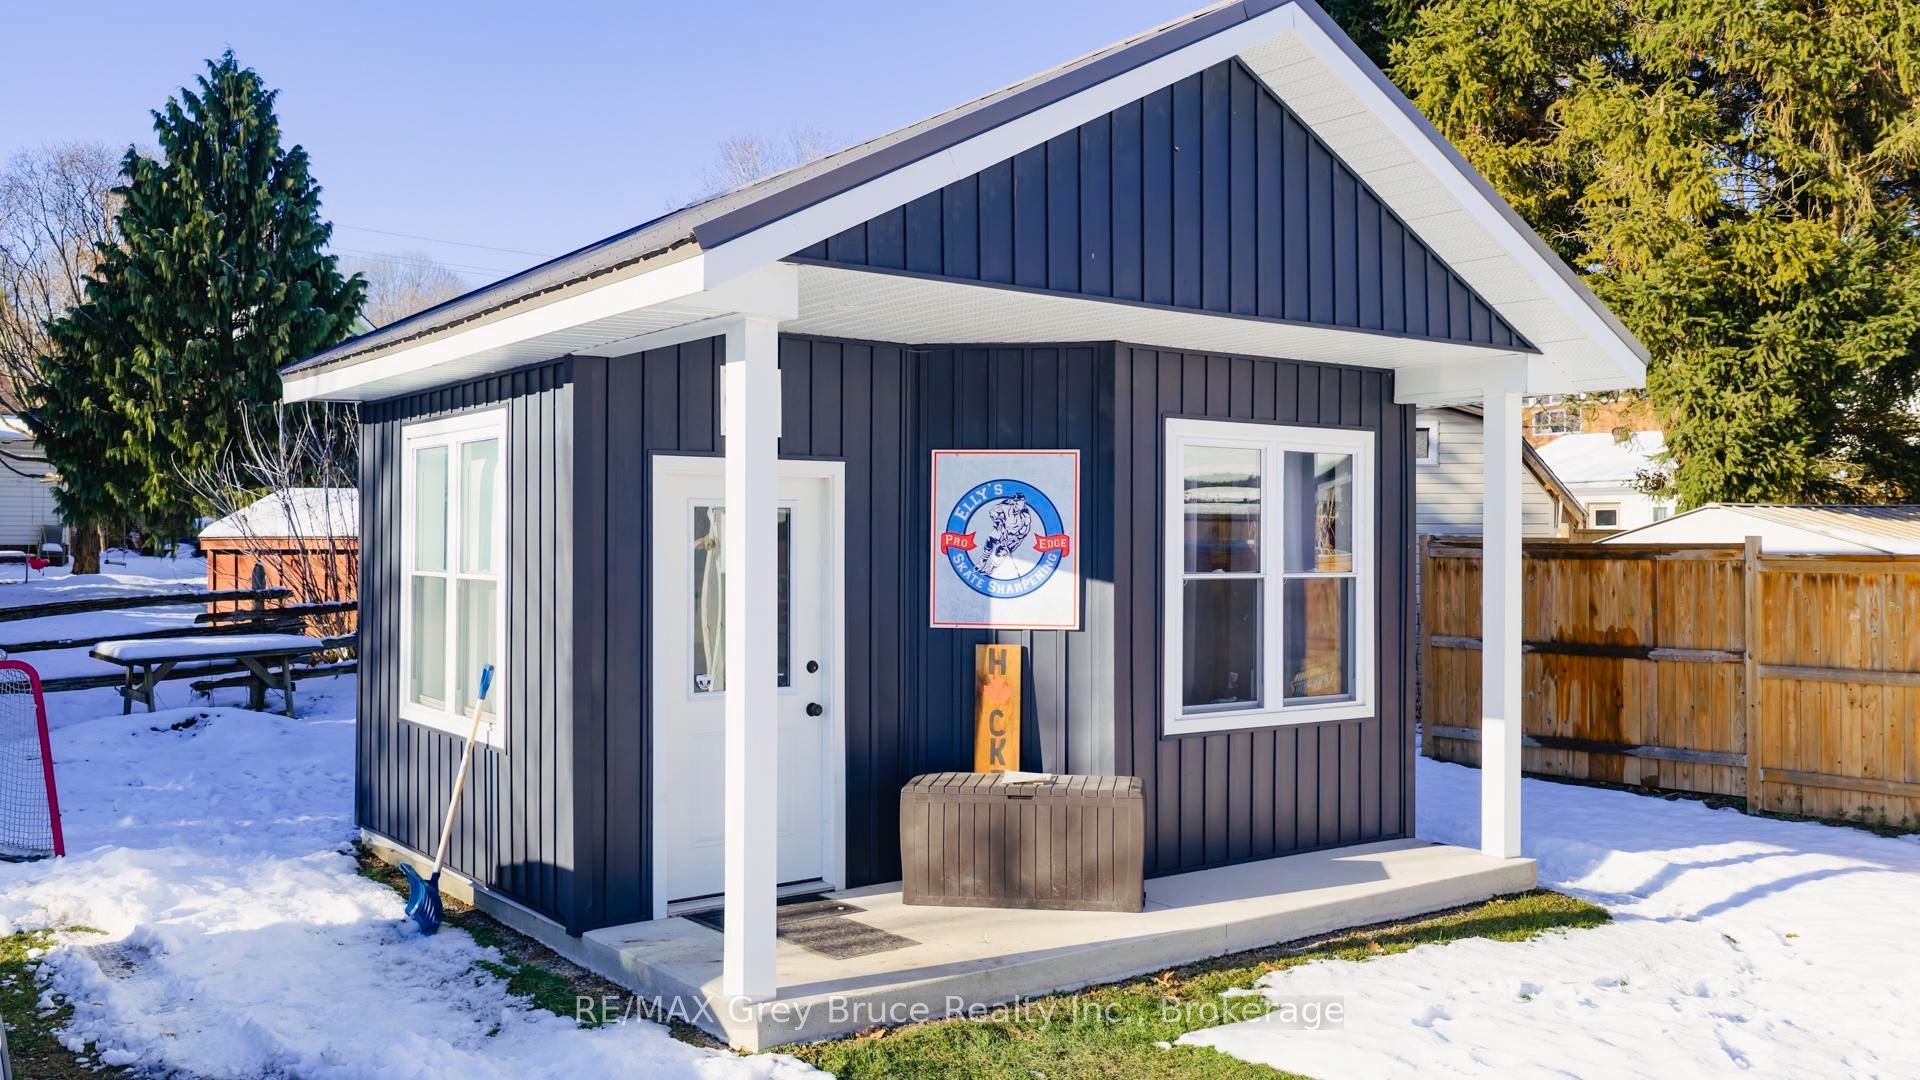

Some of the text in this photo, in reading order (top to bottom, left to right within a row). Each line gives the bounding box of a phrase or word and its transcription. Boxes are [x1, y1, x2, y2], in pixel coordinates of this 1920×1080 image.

[954, 484, 1003, 521] ELLY'S
[945, 535, 1067, 549] PRO EDGE
[953, 553, 1058, 594] SKATE SHARPENING
